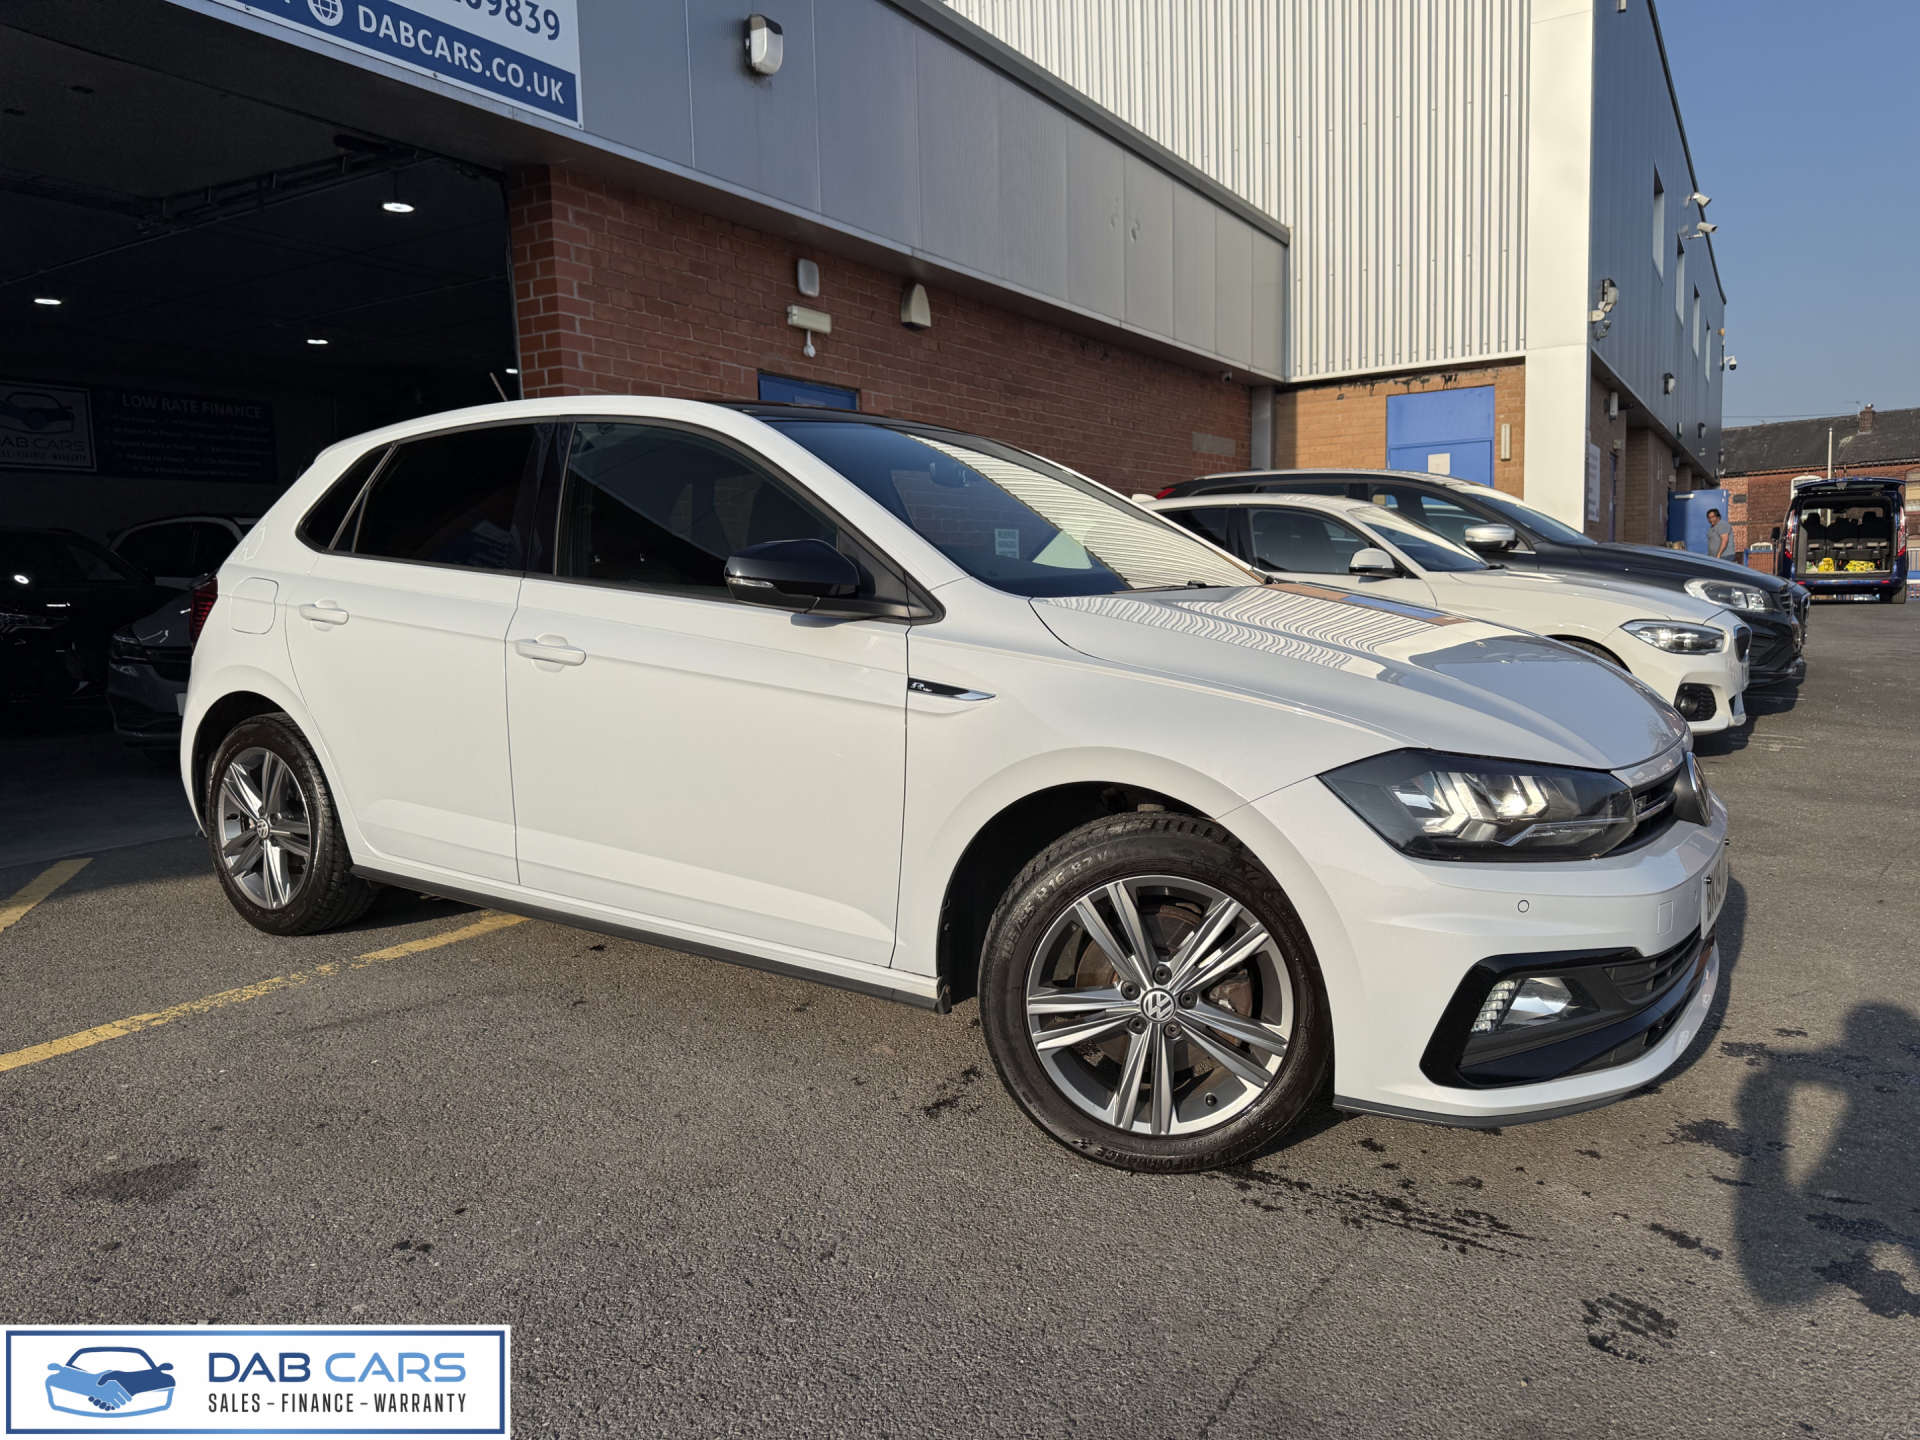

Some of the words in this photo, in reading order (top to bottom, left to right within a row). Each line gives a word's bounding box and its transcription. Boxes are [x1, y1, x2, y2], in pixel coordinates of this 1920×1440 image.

[358, 4, 565, 104] DABCARS.CO.UK
[121, 392, 158, 409] LOW
[161, 397, 200, 414] RATE
[201, 401, 265, 419] FINANCE
[0, 436, 30, 449] AB
